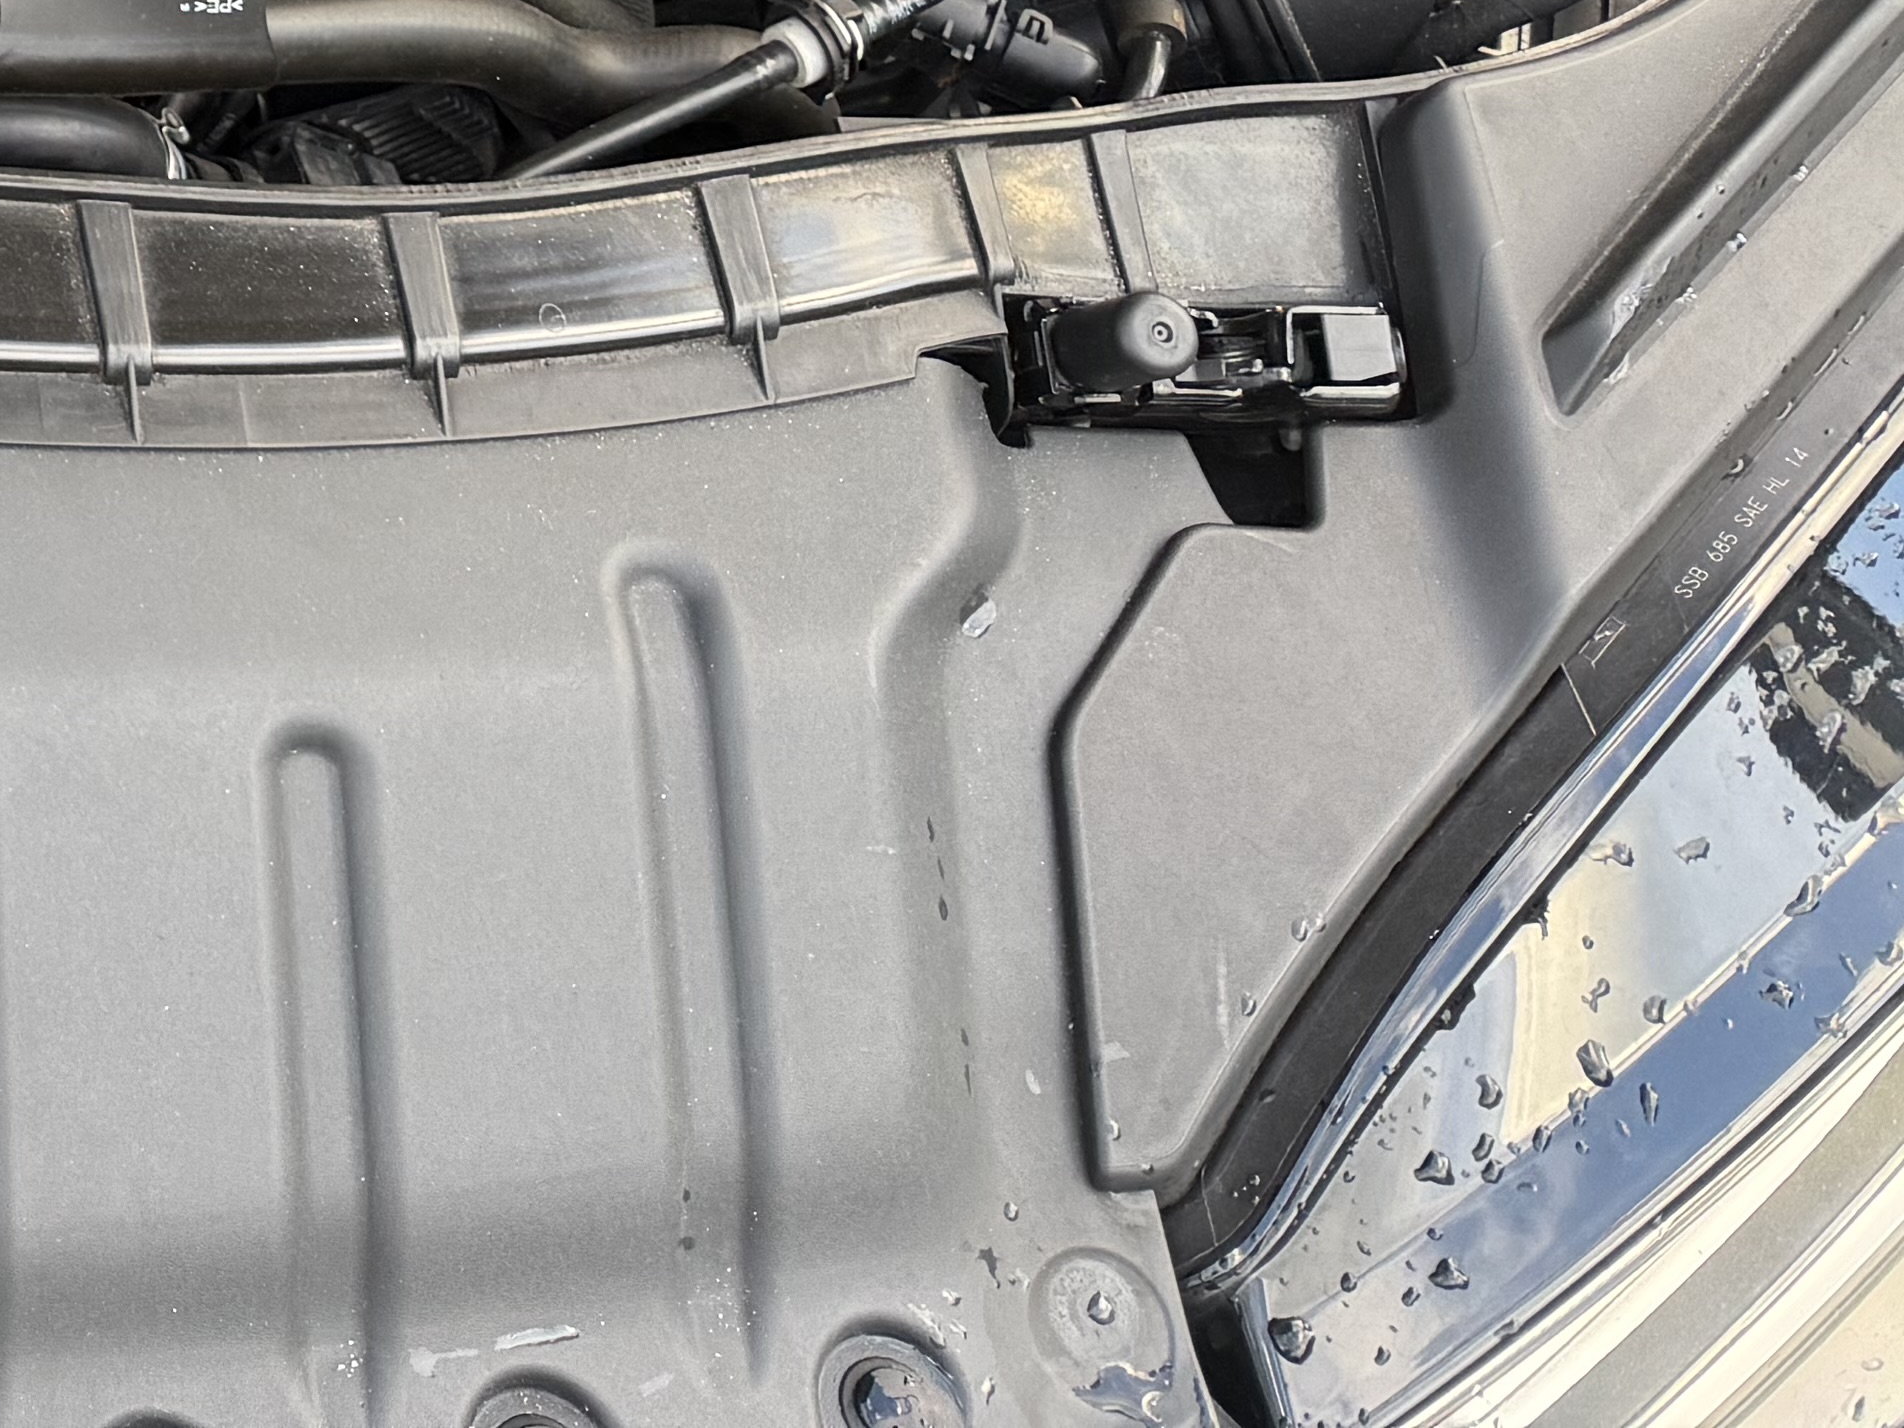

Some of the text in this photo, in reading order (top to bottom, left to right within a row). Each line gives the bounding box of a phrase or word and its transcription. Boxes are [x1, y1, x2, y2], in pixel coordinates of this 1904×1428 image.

[1674, 447, 1809, 598] SSB 685 SAE HL 14
